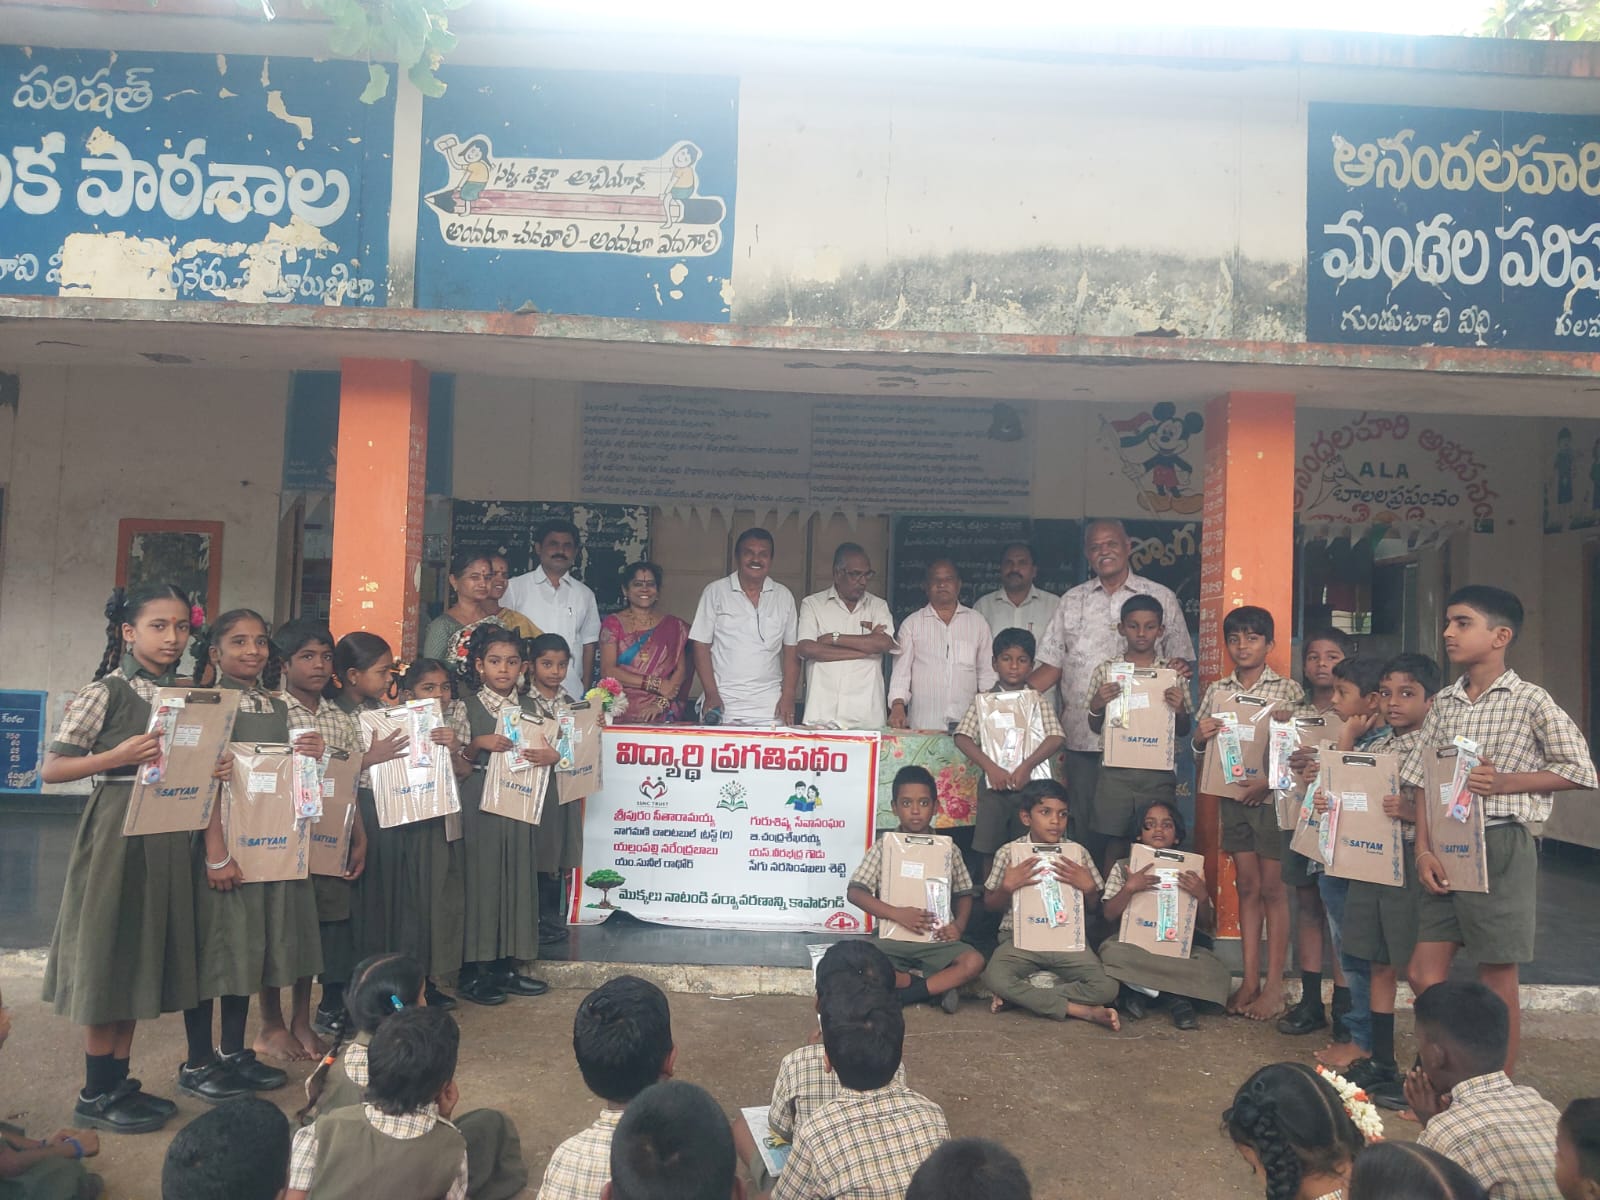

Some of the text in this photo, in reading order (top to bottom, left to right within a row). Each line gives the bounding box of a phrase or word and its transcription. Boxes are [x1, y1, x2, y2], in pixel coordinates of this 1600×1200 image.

[13, 65, 154, 118] పరిషత్
[77, 137, 350, 227] పాఠశాల
[1322, 210, 1490, 285] మండల
[1360, 462, 1409, 478] ALA
[615, 741, 848, 781] విద్యార్థి ప్రగతిపథం
[162, 786, 199, 797] SATYAM
[506, 781, 532, 795] SATYAM
[247, 836, 288, 847] SATYAM
[1350, 840, 1383, 850] SATYAM
[618, 888, 662, 904] మొక్కలు
[665, 891, 708, 904] నాటండి
